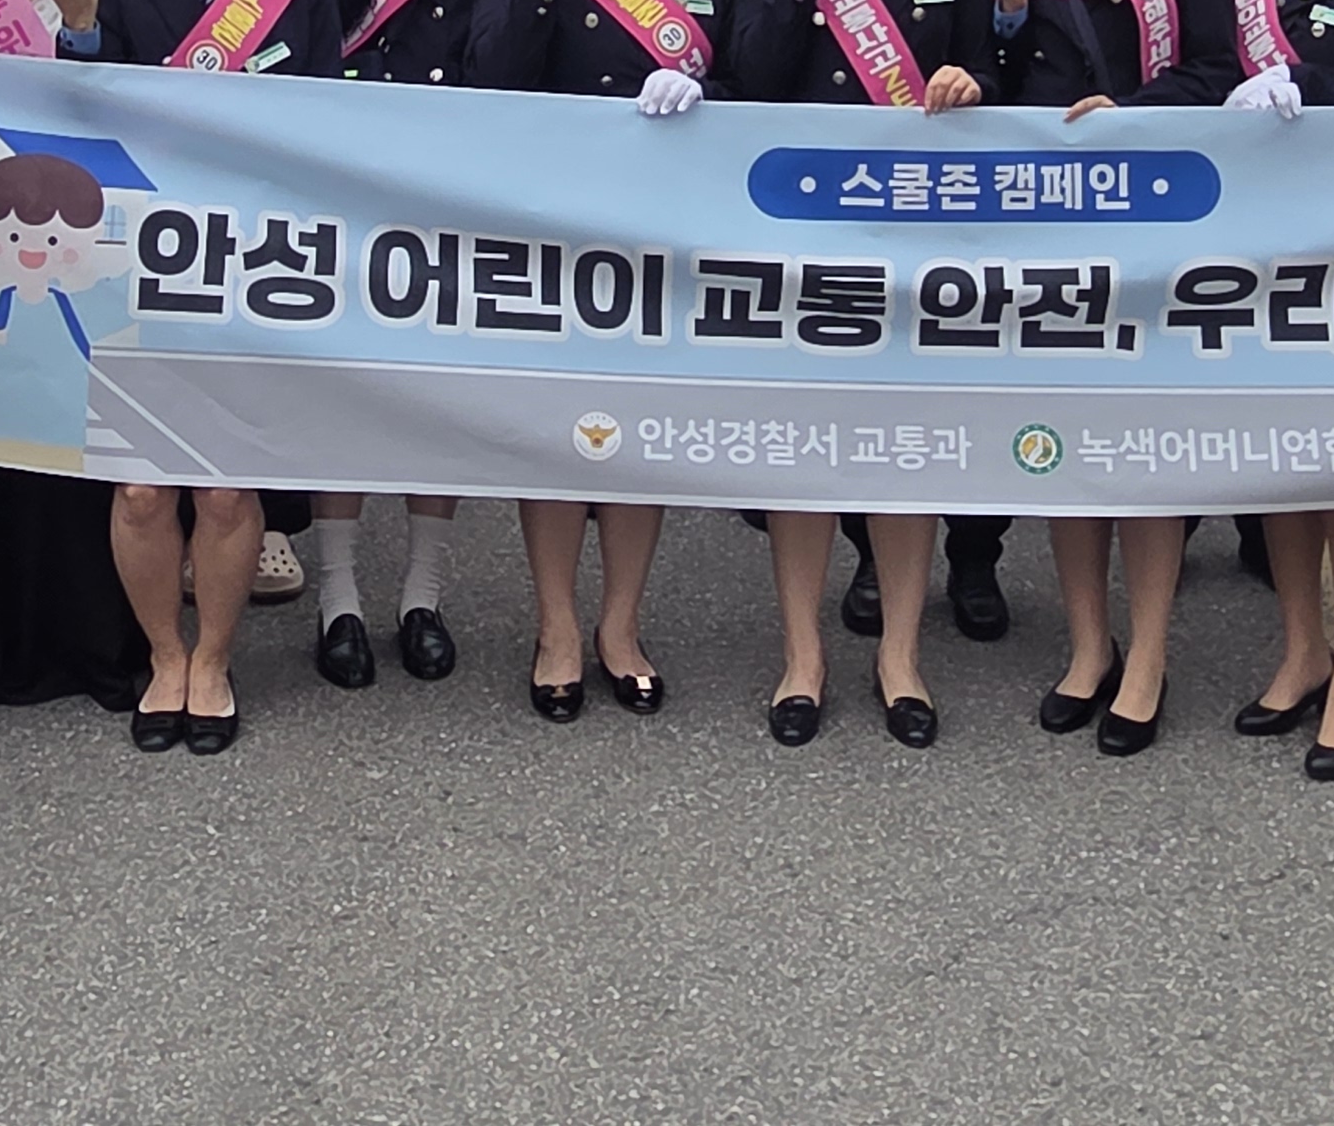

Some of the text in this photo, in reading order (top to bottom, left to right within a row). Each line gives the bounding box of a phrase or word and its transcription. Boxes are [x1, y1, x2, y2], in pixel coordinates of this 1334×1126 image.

[196, 49, 218, 71] 30
[662, 26, 682, 48] 30
[878, 64, 918, 108] ZE
[839, 161, 1132, 212] 스쿨존 캠페인
[136, 208, 338, 322] 안성
[367, 229, 666, 338] 어린이
[693, 258, 888, 348] 교통
[917, 264, 1137, 352] 안전,
[637, 416, 973, 471] 안성경찰서 교통과
